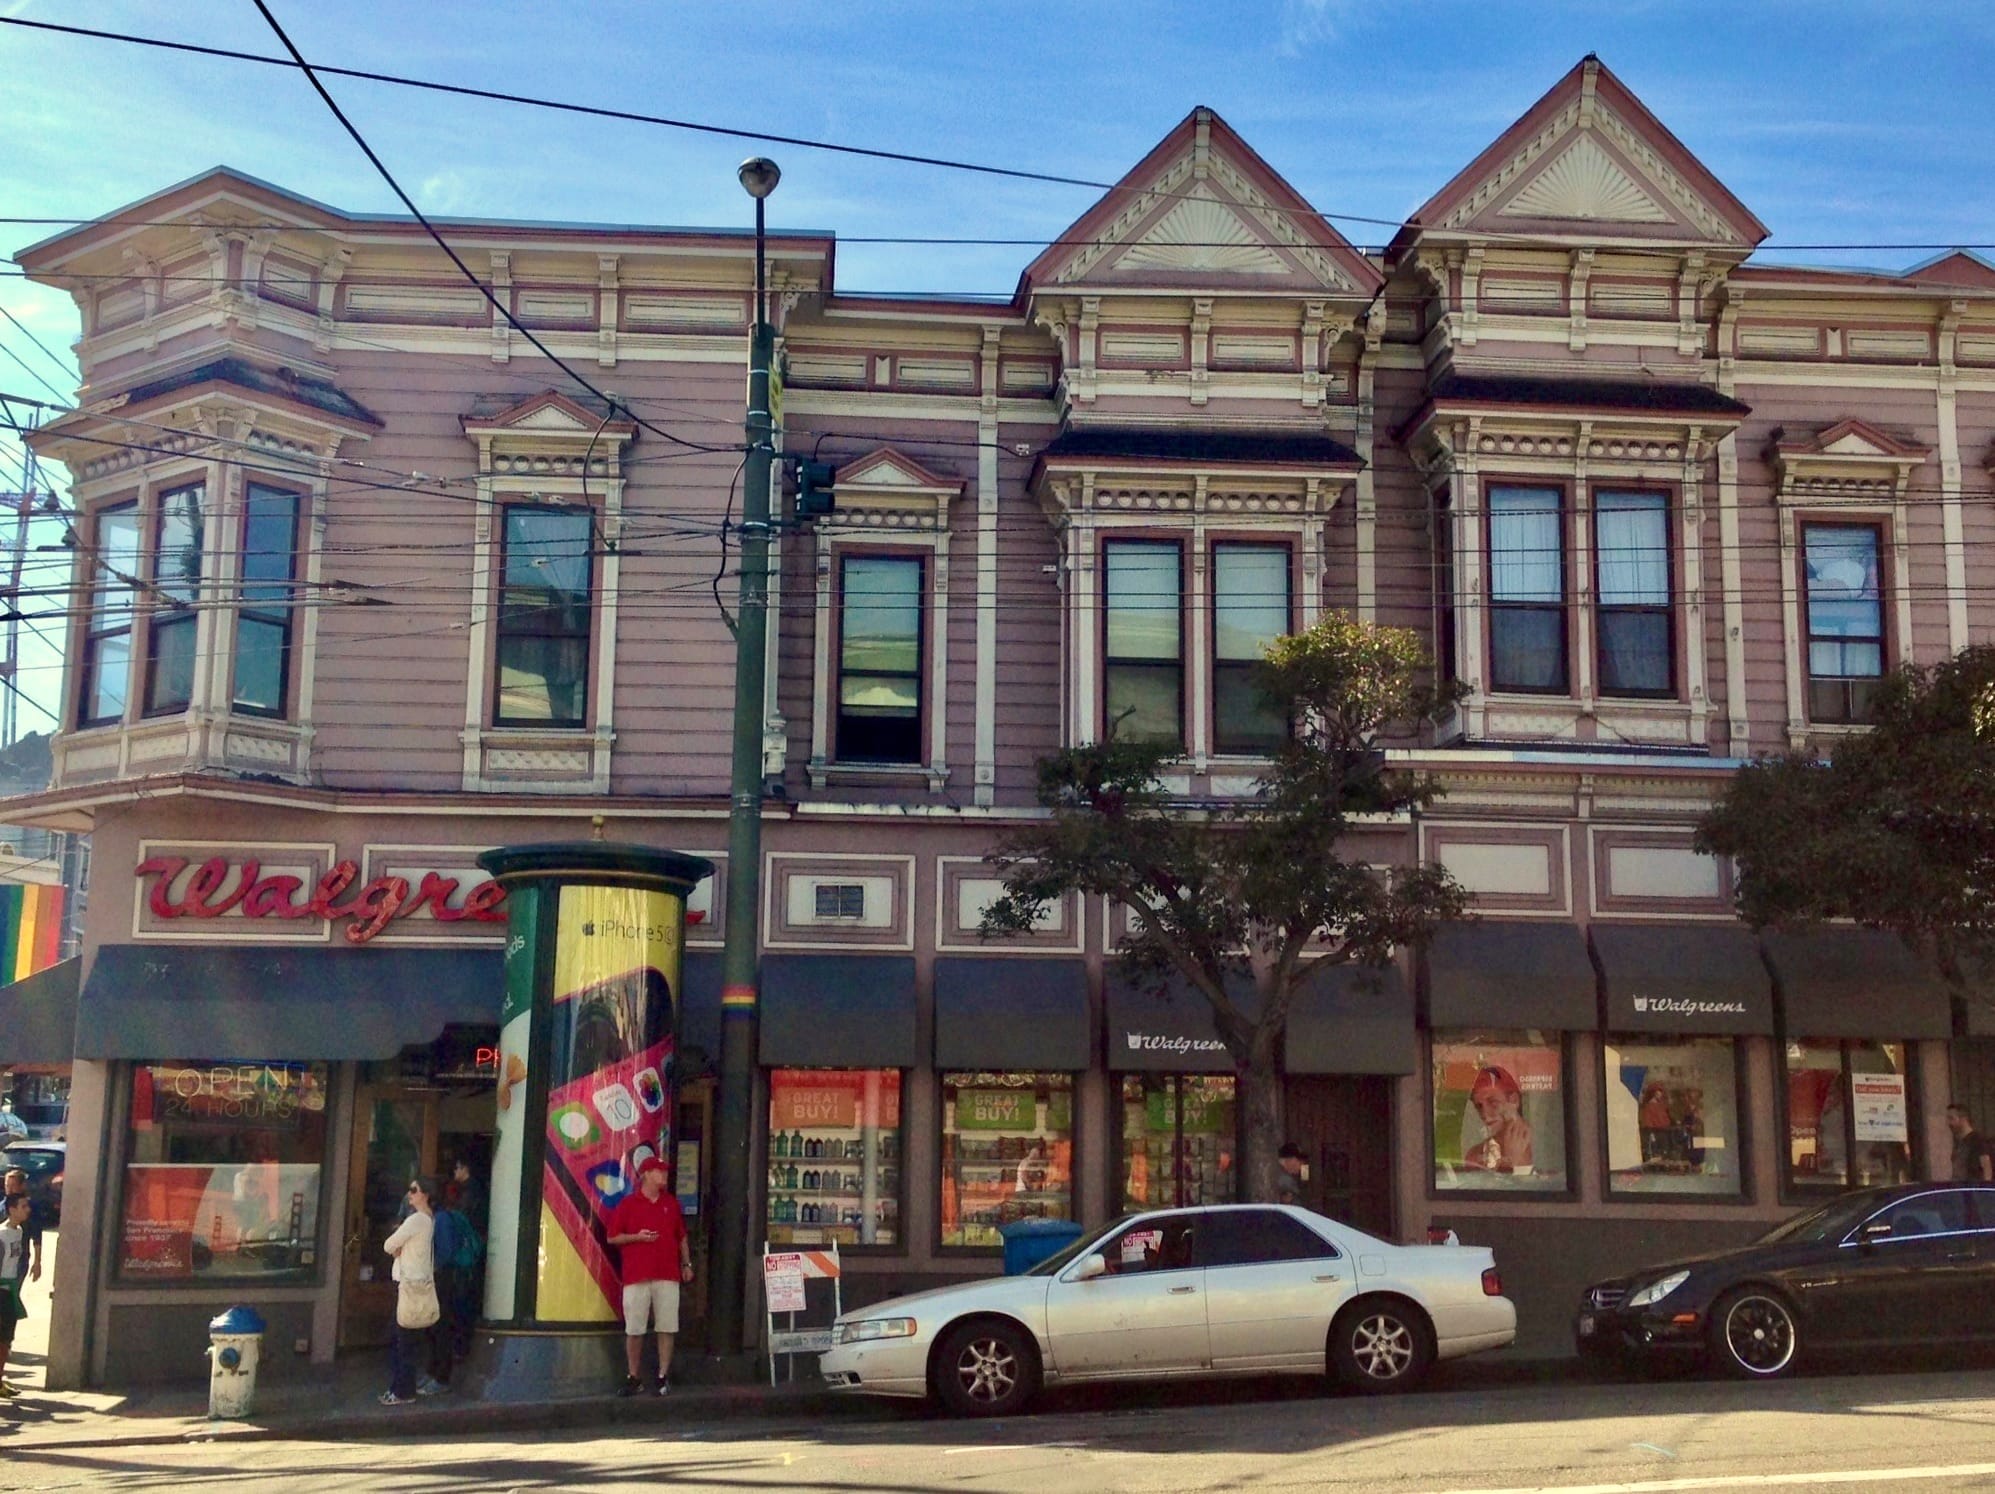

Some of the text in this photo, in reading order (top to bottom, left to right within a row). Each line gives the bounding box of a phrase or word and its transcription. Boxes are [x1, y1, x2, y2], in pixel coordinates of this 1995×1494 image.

[135, 857, 706, 944] Walgre
[601, 919, 654, 941] iPhone
[1649, 997, 1746, 1017] Walgreens
[1141, 1035, 1227, 1054] Walgreen
[175, 1065, 289, 1098] OPEN
[792, 1092, 839, 1104] GREAT
[974, 1094, 1019, 1106] GREAT
[164, 1100, 292, 1118] 24 HOURS
[606, 1098, 632, 1120] 10
[793, 1104, 839, 1119] BUY!
[975, 1106, 1020, 1121] BUY!
